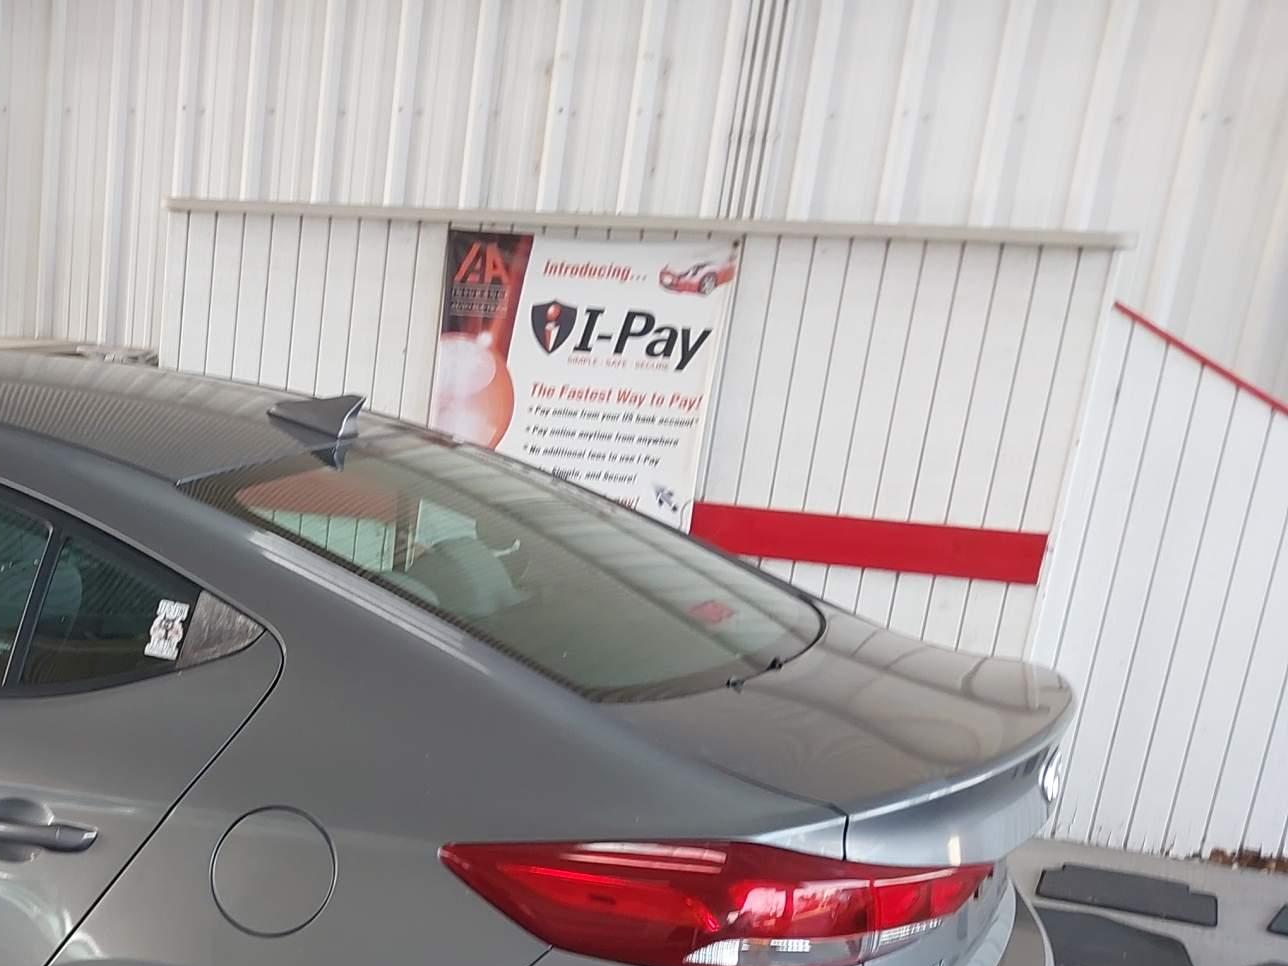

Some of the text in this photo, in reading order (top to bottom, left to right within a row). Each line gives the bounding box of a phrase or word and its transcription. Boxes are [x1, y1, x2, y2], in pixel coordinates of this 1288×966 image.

[543, 260, 647, 281] Introducing...
[572, 307, 712, 372] I-Pay
[531, 383, 704, 412] The Fastest Way to Pay!
[534, 405, 550, 417] Pay
[552, 407, 577, 417] online
[580, 408, 600, 418] from
[601, 412, 619, 422] your
[635, 413, 656, 424] bank
[532, 425, 679, 447] Pay online anytime from anywhere
[542, 446, 586, 458] additional
